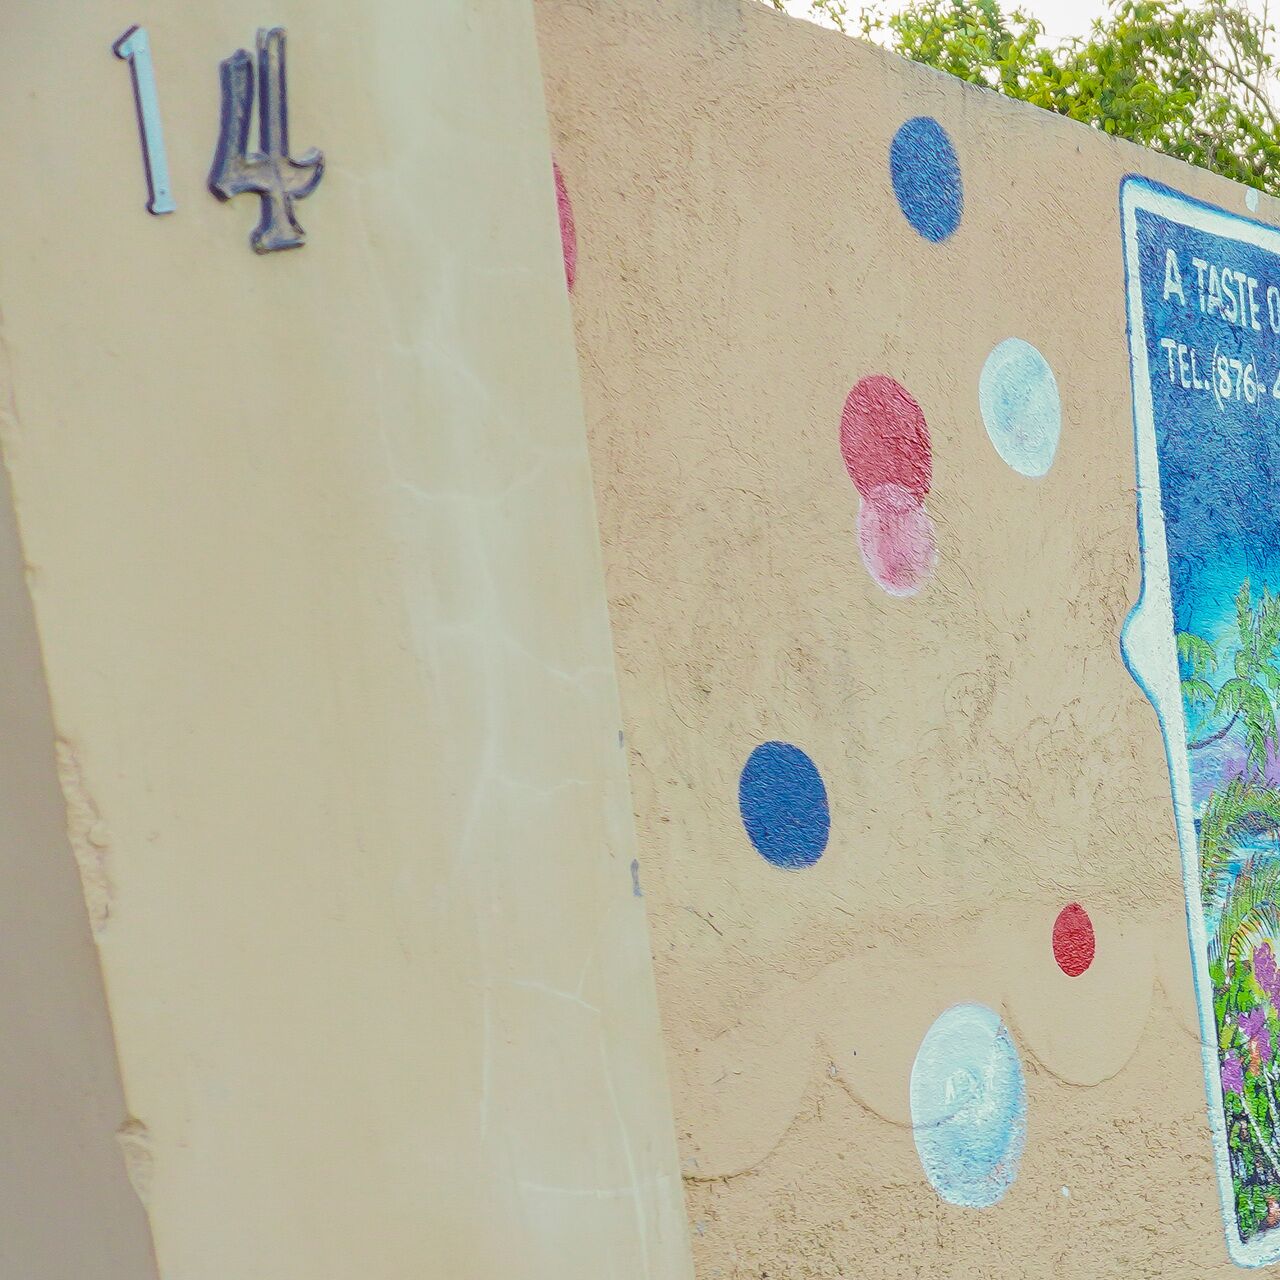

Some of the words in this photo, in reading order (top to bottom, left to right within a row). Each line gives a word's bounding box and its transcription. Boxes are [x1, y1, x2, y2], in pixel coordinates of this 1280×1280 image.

[112, 24, 325, 254] 14
[1163, 248, 1186, 306] A
[1192, 256, 1262, 331] TASTE
